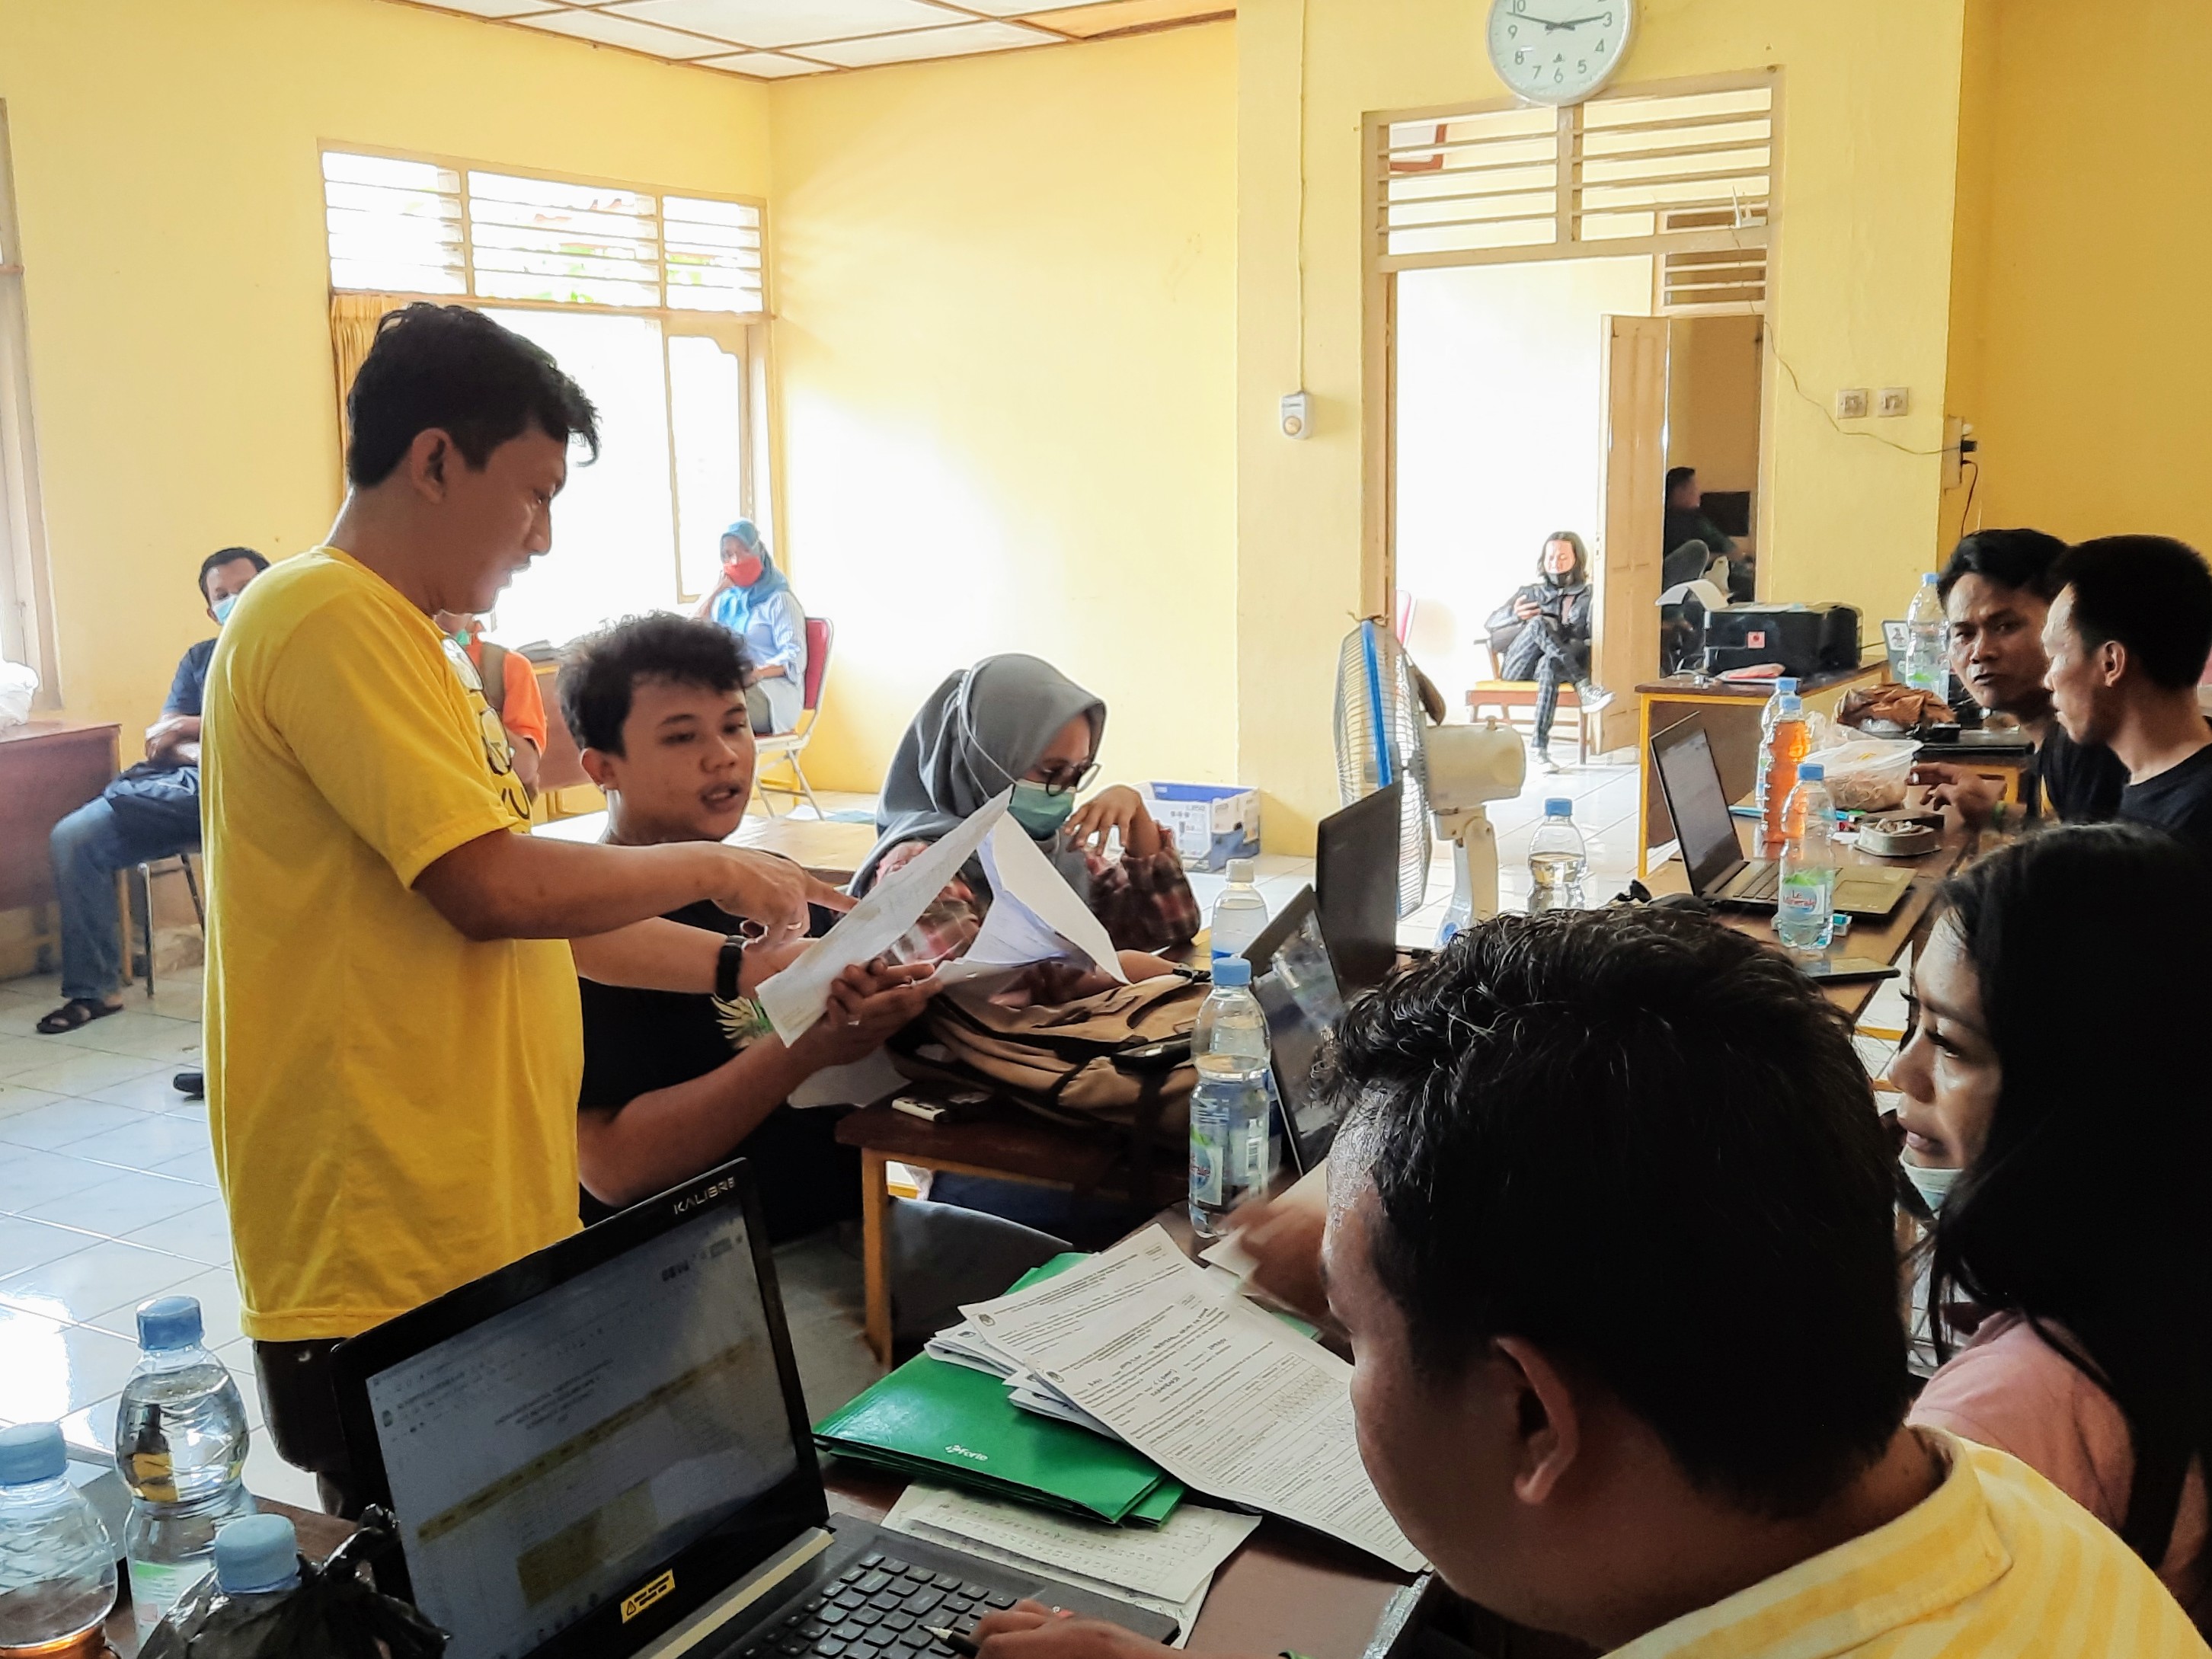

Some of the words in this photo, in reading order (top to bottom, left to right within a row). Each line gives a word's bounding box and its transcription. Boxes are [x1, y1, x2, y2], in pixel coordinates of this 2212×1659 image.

[1512, 0, 1526, 14] 10
[1602, 11, 1613, 27] 3
[1507, 24, 1518, 40] 9
[1594, 38, 1605, 53] 4
[1514, 50, 1524, 66] 8
[1532, 65, 1542, 80] 7
[1553, 66, 1564, 83] 6
[1577, 59, 1587, 75] 5
